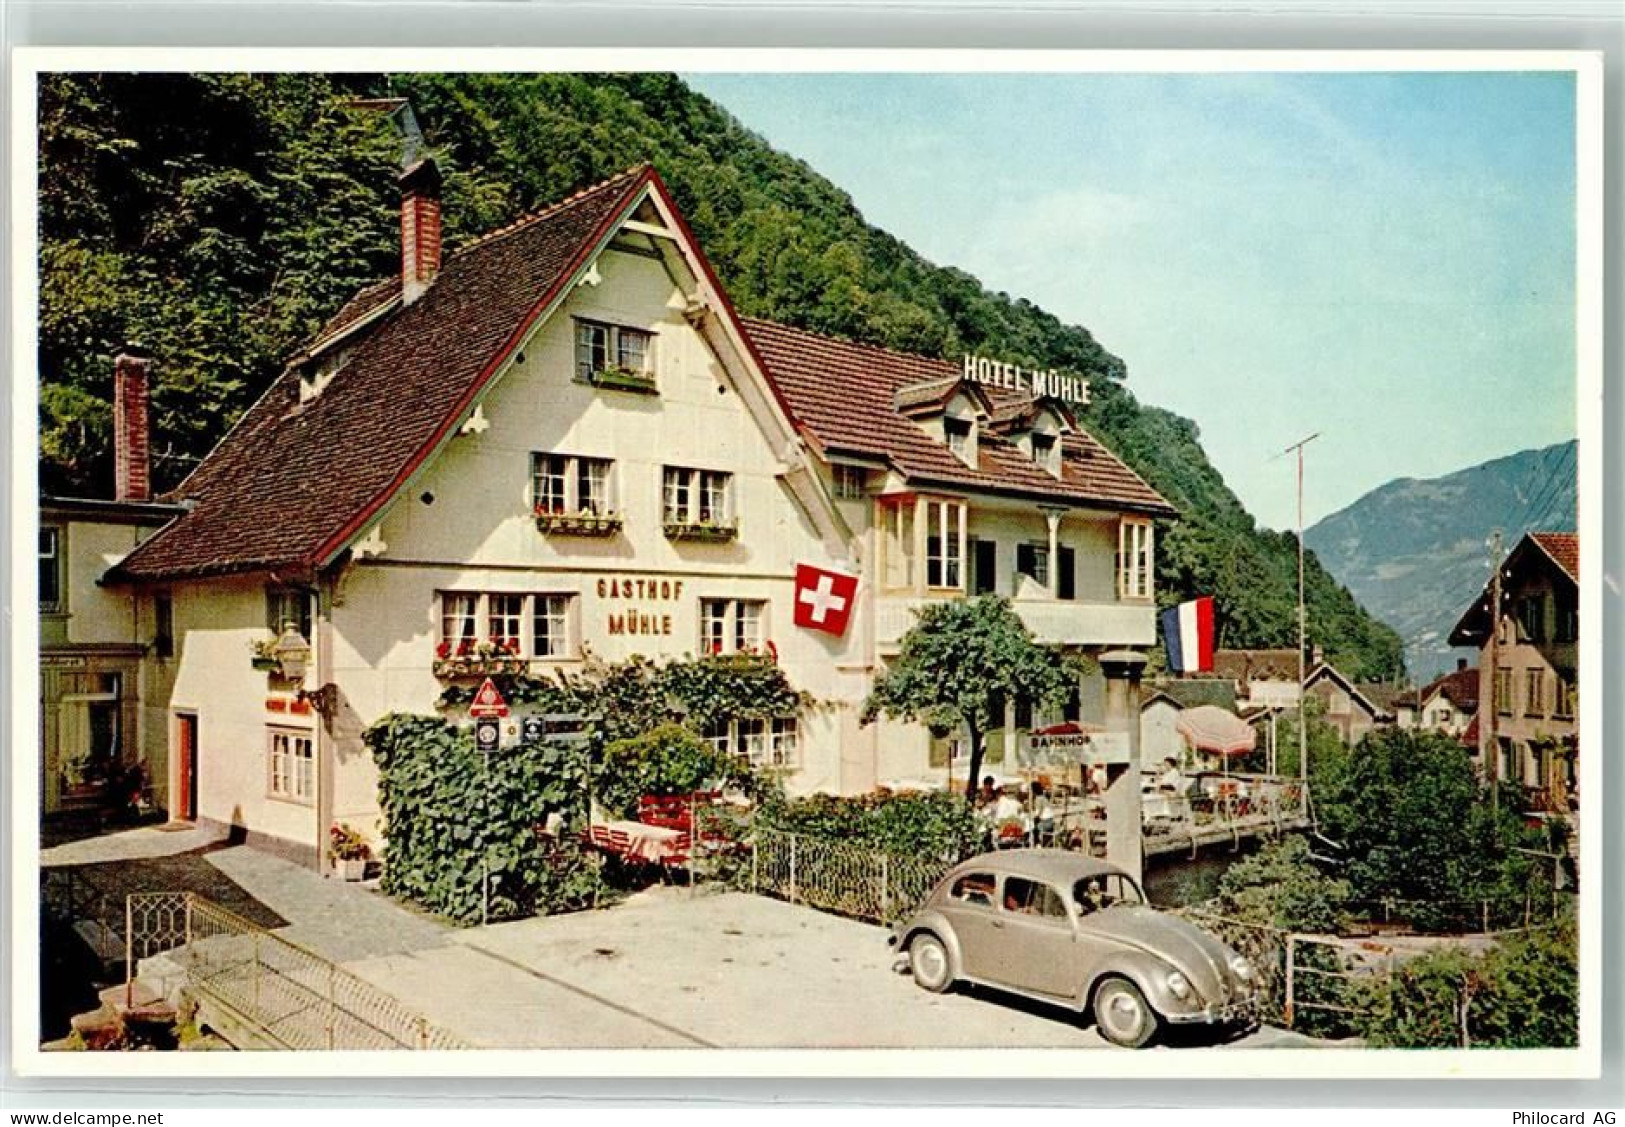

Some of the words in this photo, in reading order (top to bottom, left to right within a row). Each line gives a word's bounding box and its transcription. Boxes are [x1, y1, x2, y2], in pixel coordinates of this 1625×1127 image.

[964, 353, 1025, 391] HOTEL
[1032, 368, 1091, 404] MÜHLE
[597, 579, 683, 600] GASTHOF
[609, 608, 672, 634] MÜHLE
